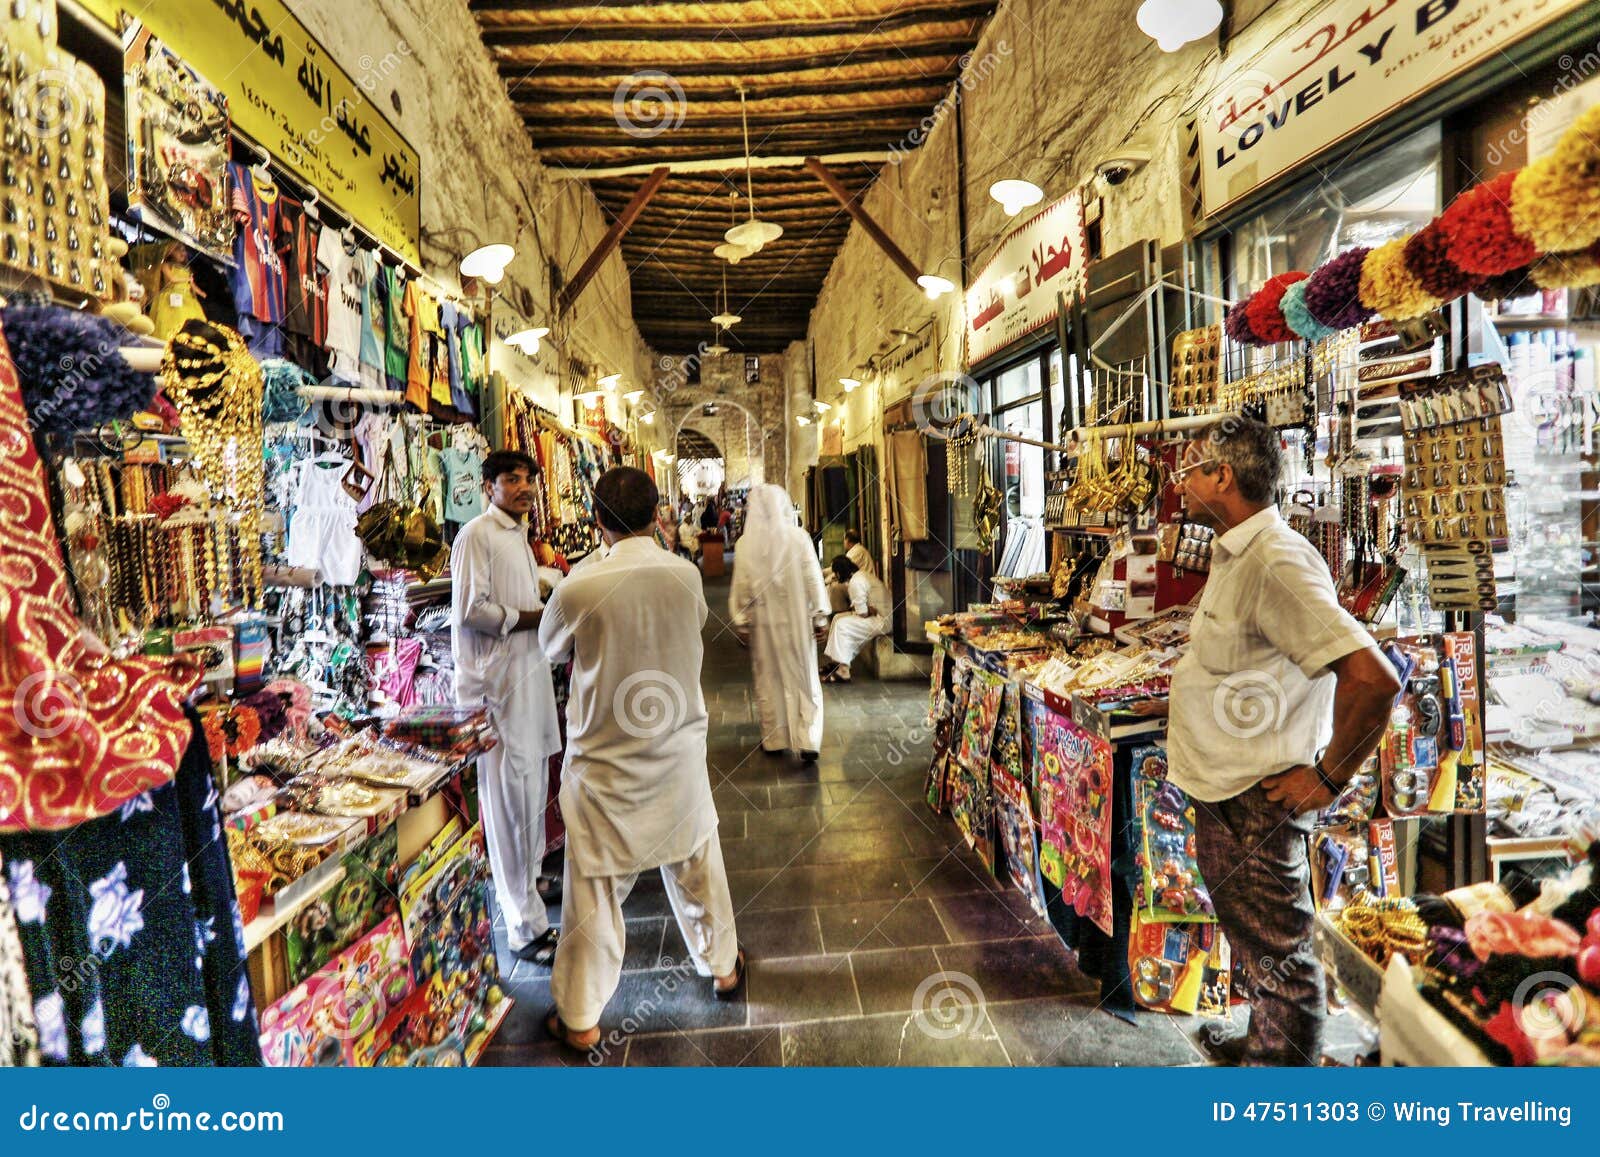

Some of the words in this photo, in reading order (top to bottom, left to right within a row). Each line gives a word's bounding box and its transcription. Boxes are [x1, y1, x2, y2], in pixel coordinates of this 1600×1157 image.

[298, 41, 332, 117] الله
[1217, 24, 1396, 169] LOVELY
[336, 97, 372, 158] عبد
[378, 149, 414, 198] متجر
